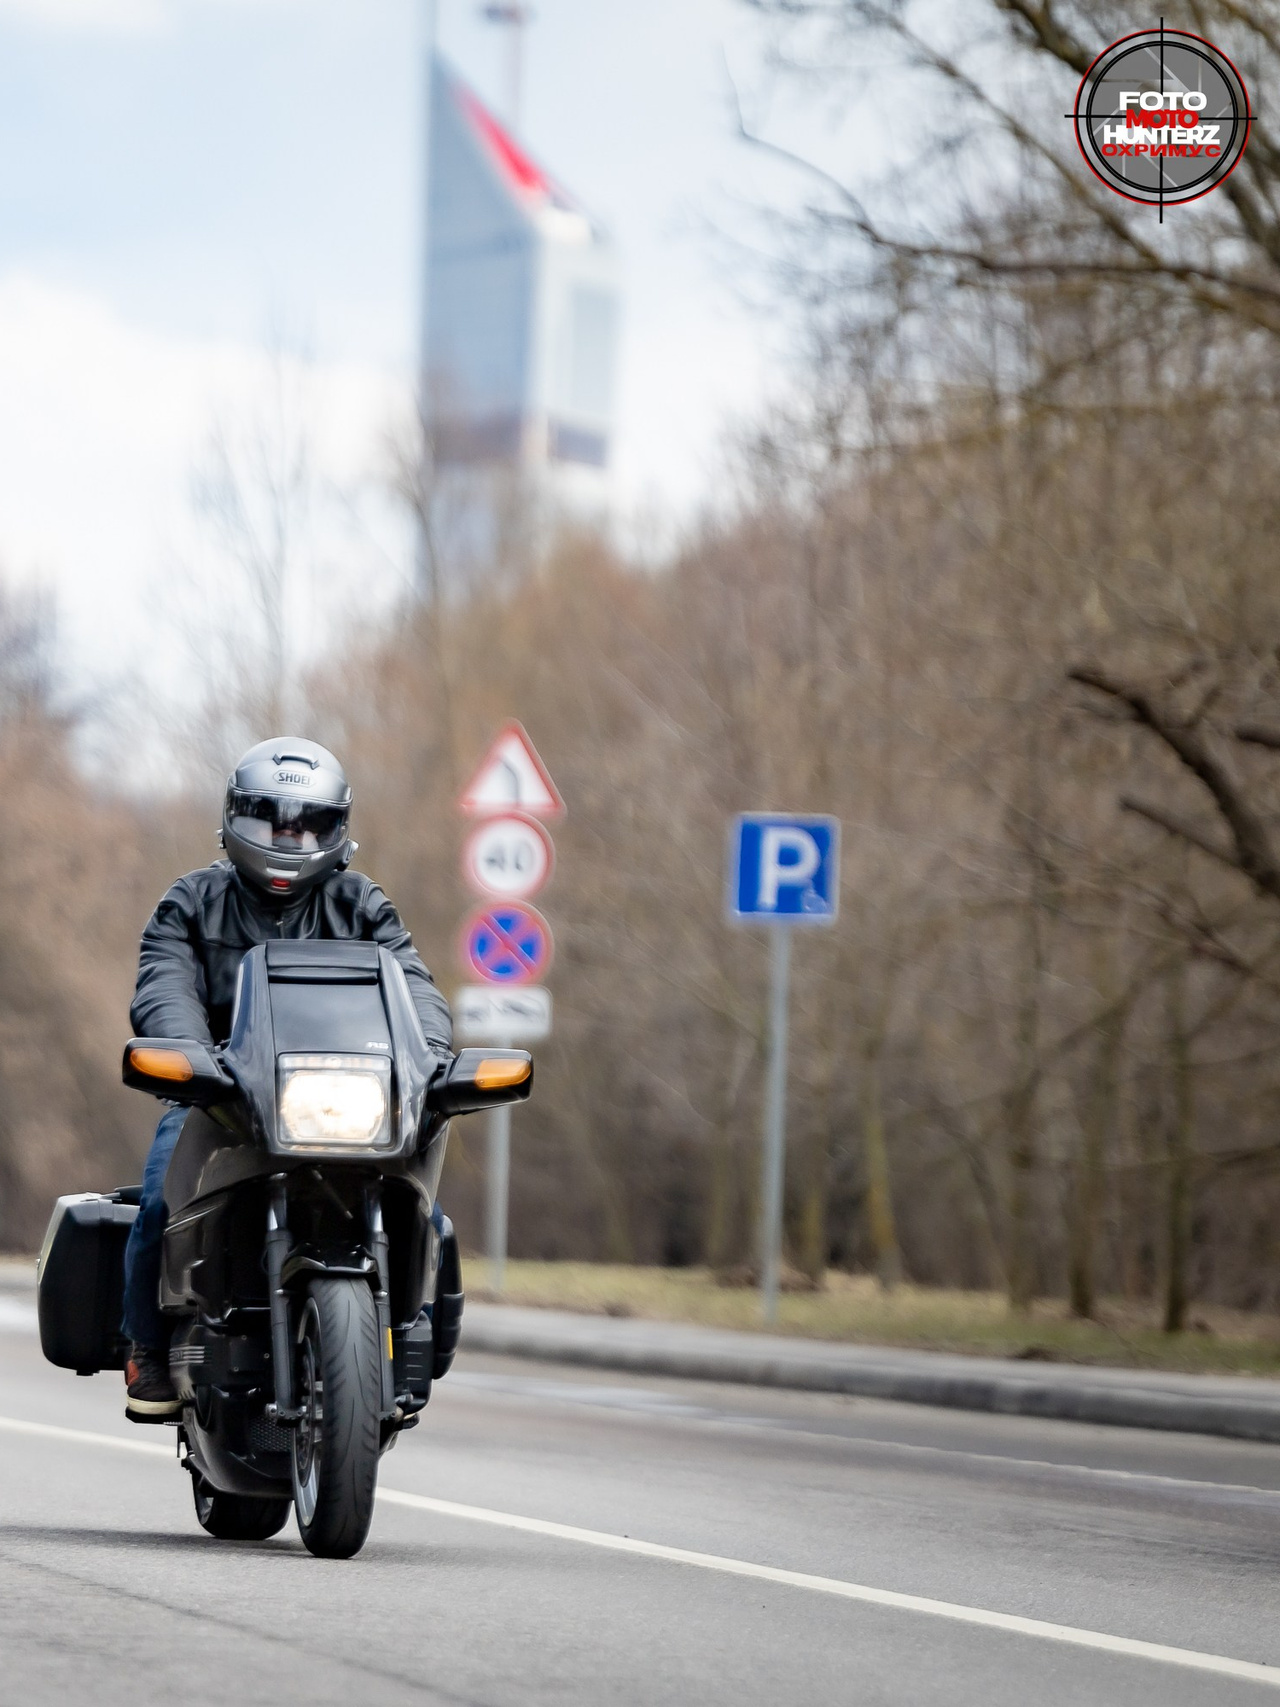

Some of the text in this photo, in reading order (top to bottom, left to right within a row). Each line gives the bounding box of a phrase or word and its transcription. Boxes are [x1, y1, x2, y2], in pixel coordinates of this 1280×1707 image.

[278, 772, 310, 785] SHOEI
[485, 837, 536, 873] 40
[761, 828, 820, 908] P
